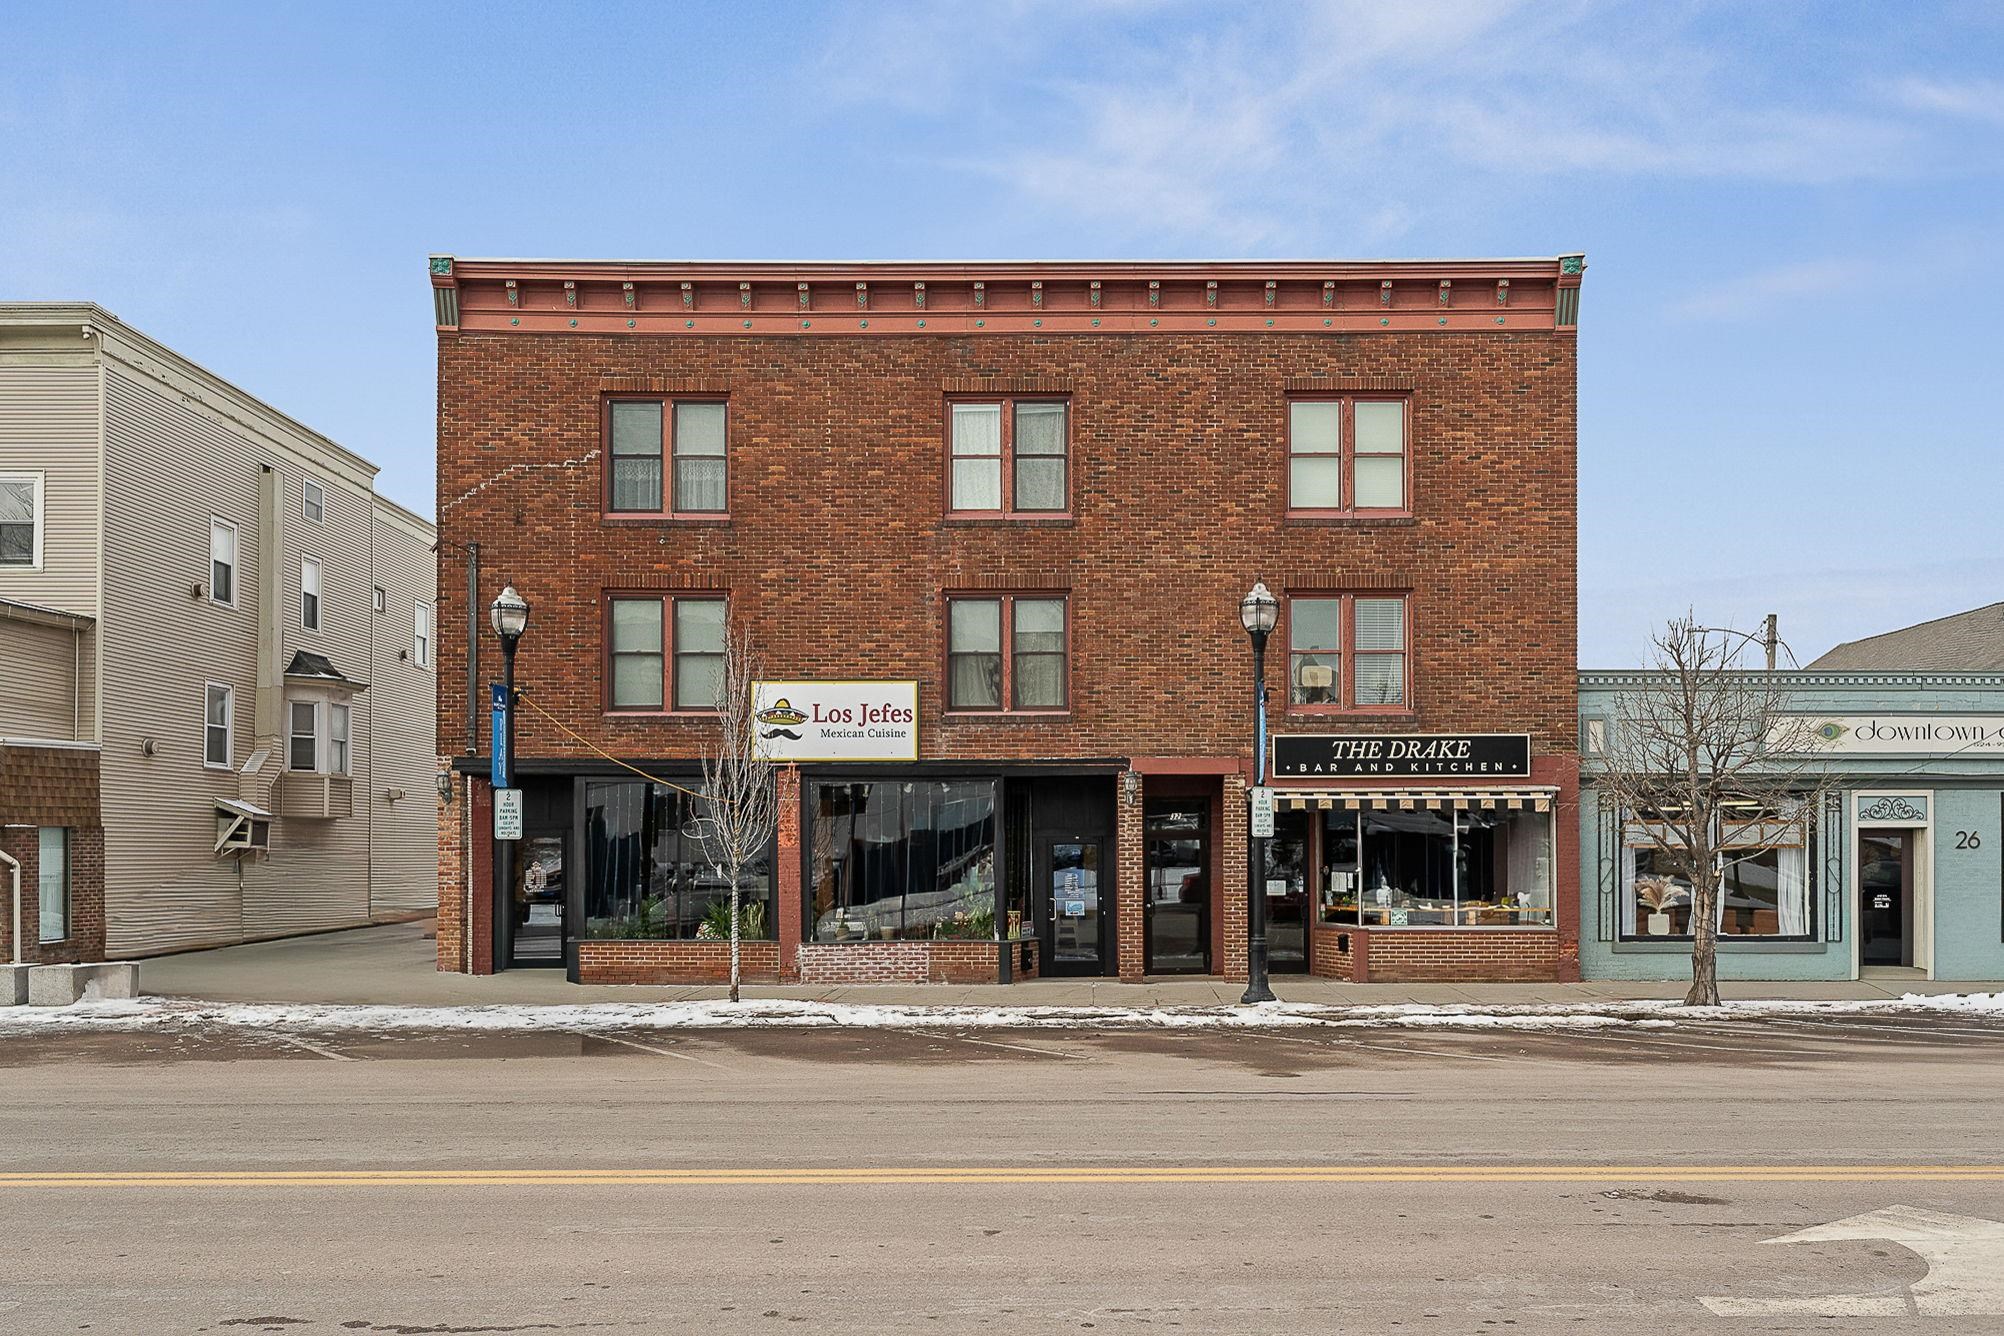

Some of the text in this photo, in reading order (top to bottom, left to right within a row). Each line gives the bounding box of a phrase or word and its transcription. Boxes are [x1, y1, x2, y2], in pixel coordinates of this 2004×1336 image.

[812, 702, 913, 728] Los Jefes
[820, 728, 907, 738] Mexican Cuisine
[1854, 720, 1985, 741] downtown
[1331, 739, 1472, 760] THE DRAKE
[1299, 762, 1503, 772] BAR AND KITCHEN
[1954, 830, 1981, 850] 26
